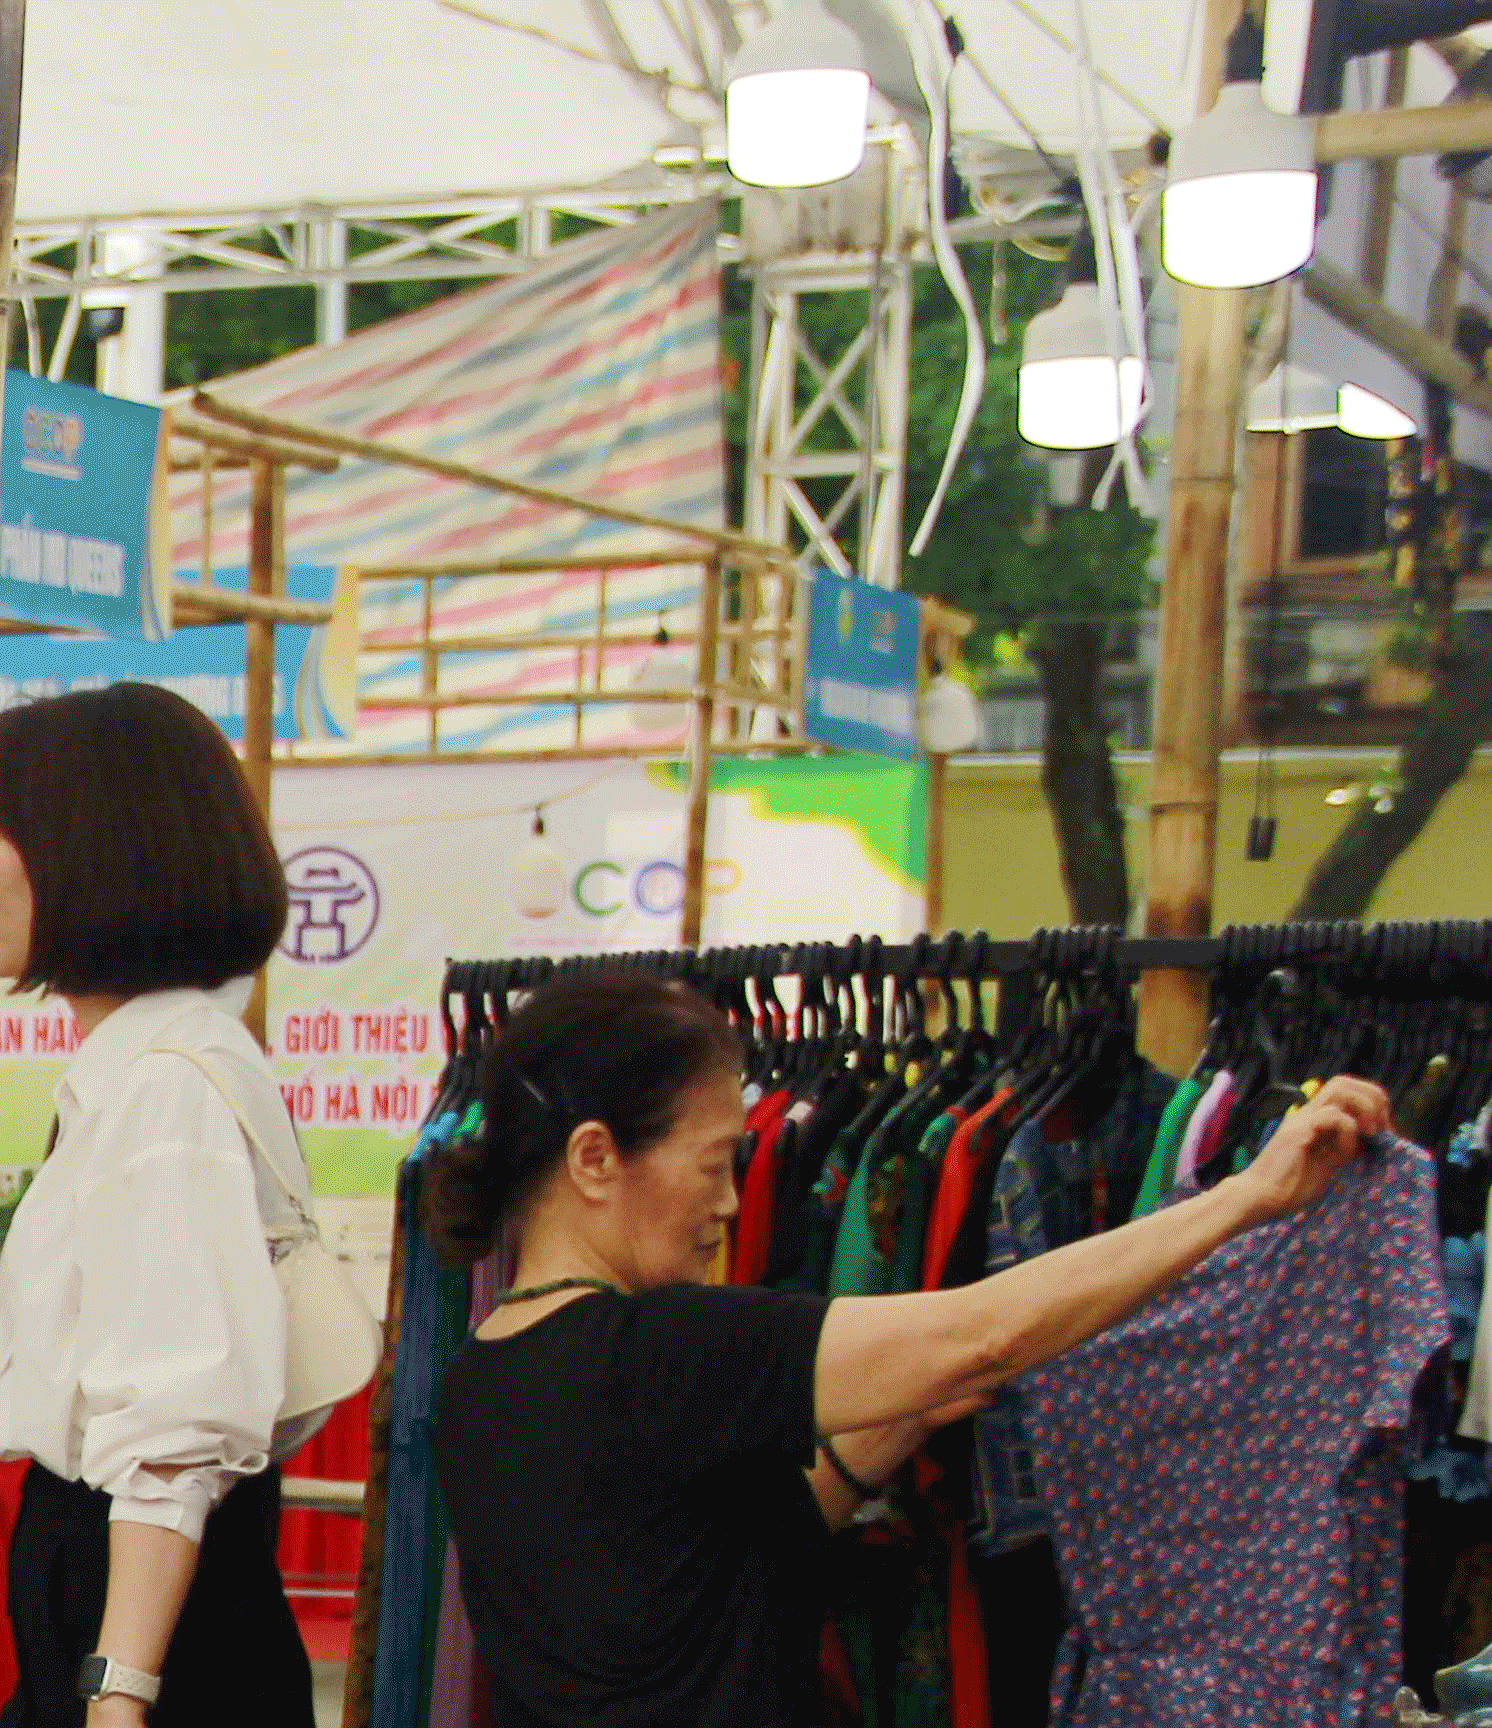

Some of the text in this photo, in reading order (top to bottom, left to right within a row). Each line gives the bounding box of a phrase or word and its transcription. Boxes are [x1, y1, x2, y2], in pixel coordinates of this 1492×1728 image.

[519, 859, 744, 918] COP
[285, 1006, 429, 1062] GIỚI THIỆU
[279, 1070, 418, 1132] HỐ HÀ NỘI
